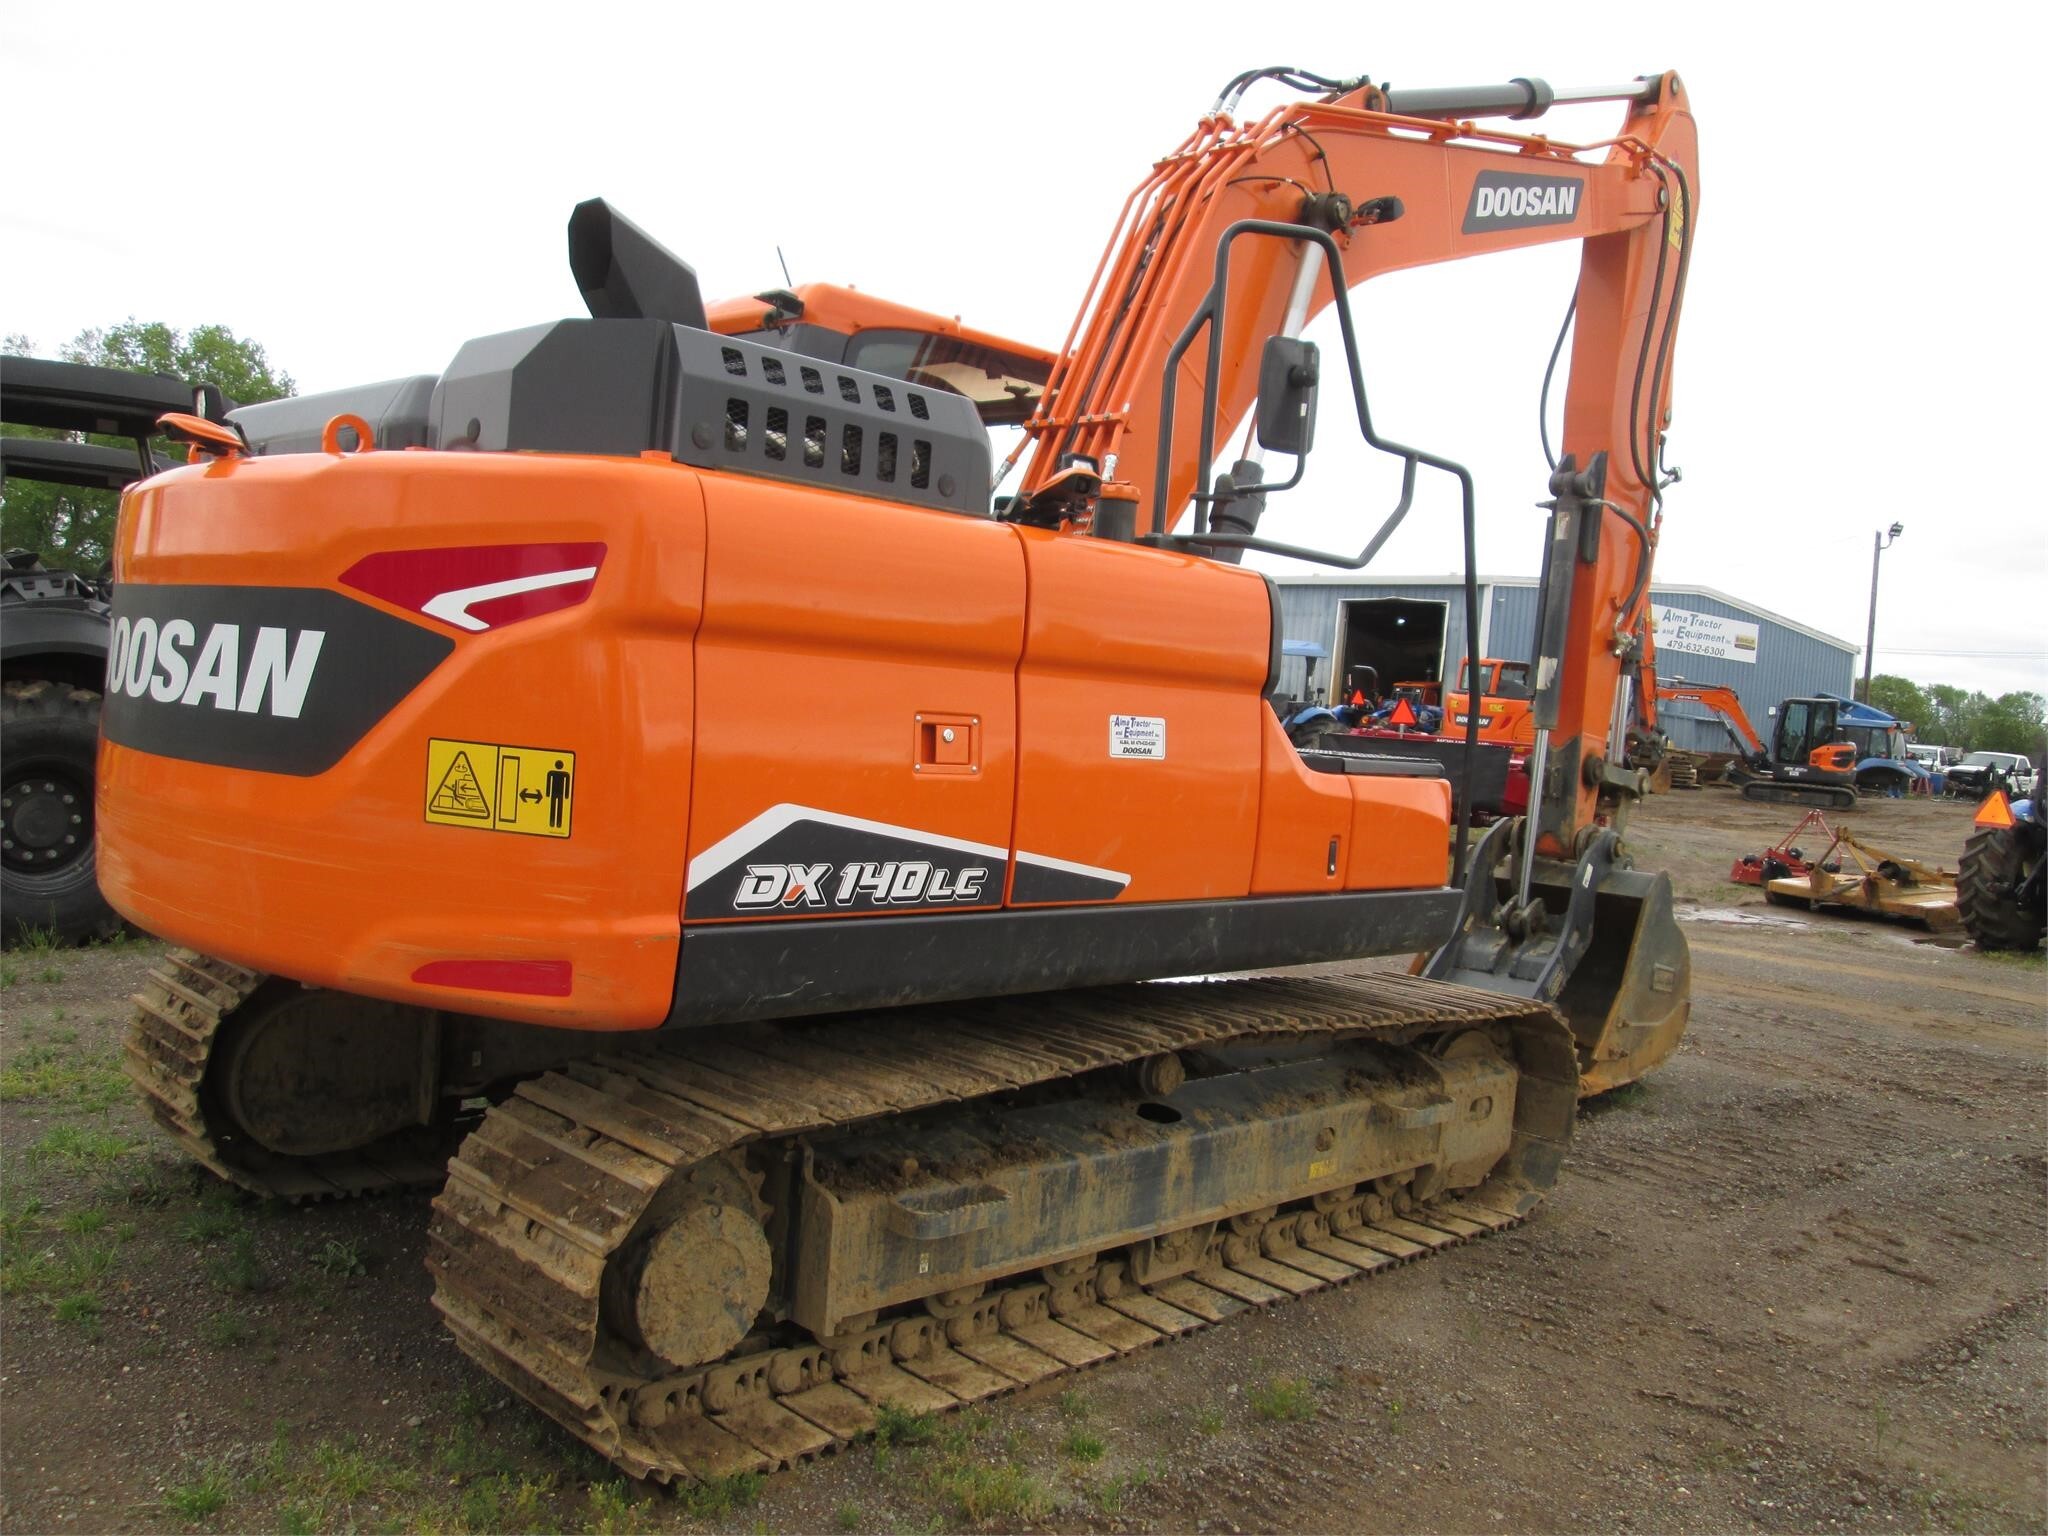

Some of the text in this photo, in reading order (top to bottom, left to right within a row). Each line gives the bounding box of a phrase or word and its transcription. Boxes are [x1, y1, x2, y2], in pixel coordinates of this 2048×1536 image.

[1475, 186, 1576, 218] DOOSAN
[1663, 609, 1723, 630] Alma Tractor
[1676, 625, 1726, 644] Equipment
[1667, 640, 1726, 657] 479-632-6300
[1114, 716, 1151, 728] Alma Tractor
[1456, 715, 1489, 725] DOAN
[1124, 727, 1154, 738] Equipment
[1123, 747, 1152, 755] DOOSAN
[734, 862, 834, 909] DX
